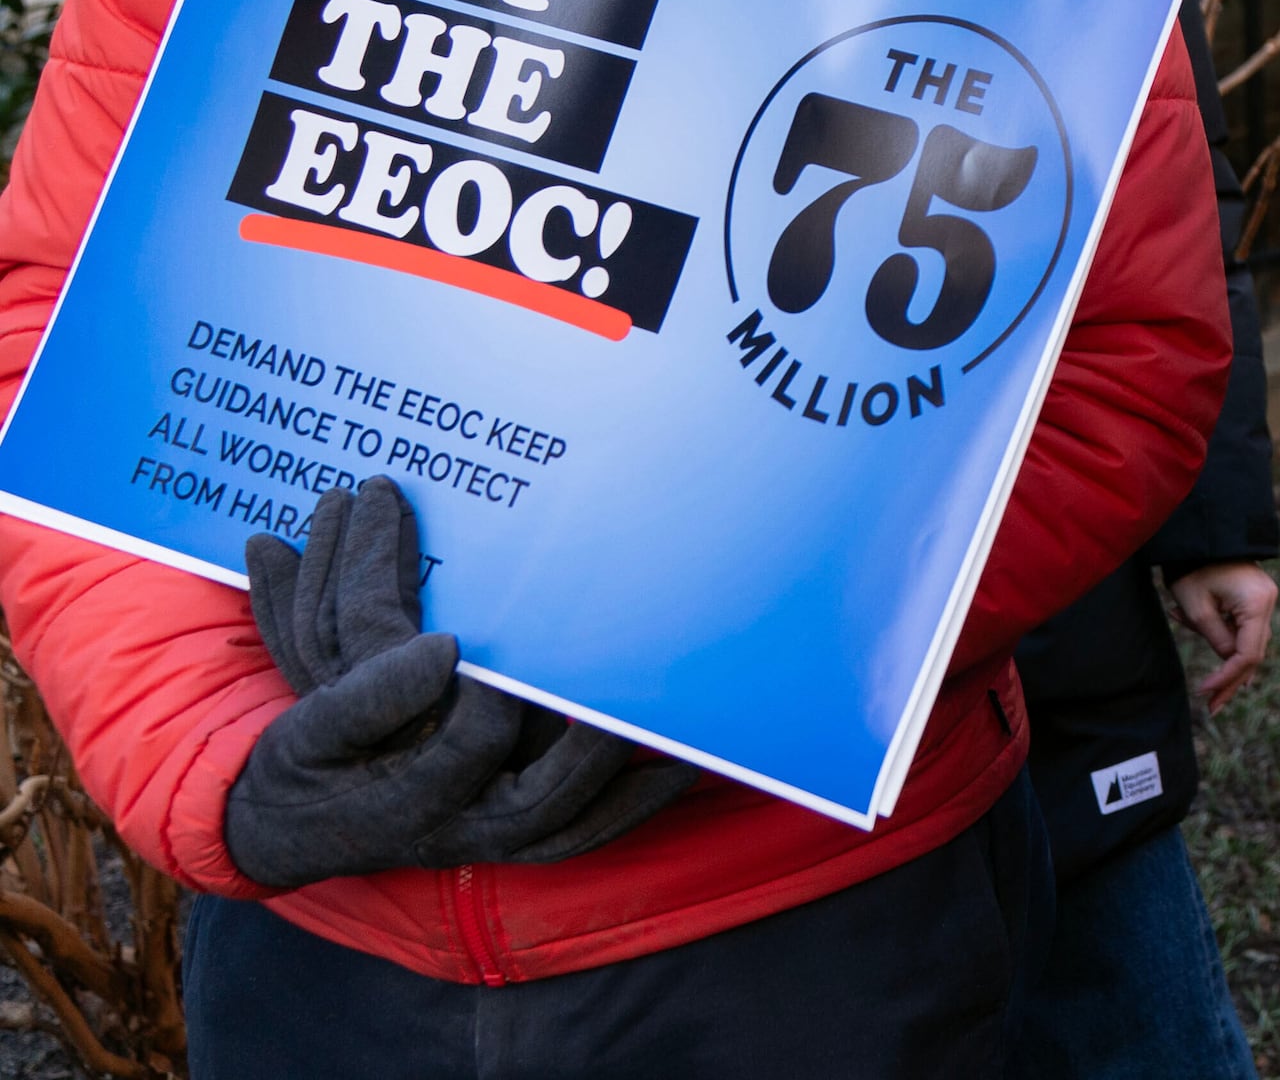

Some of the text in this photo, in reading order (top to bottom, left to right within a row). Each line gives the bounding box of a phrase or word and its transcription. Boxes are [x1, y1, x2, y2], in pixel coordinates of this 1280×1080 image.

[884, 48, 993, 116] THE
[265, 108, 633, 298] EEOC!
[767, 91, 1039, 351] 75
[186, 320, 567, 466] DEMAND THE EEOC KEEP
[725, 308, 946, 427] MILLION
[131, 456, 225, 512] FROM
[148, 412, 366, 496] ALL WORKER
[169, 366, 530, 509] GUIDANCE TO PROTECT
